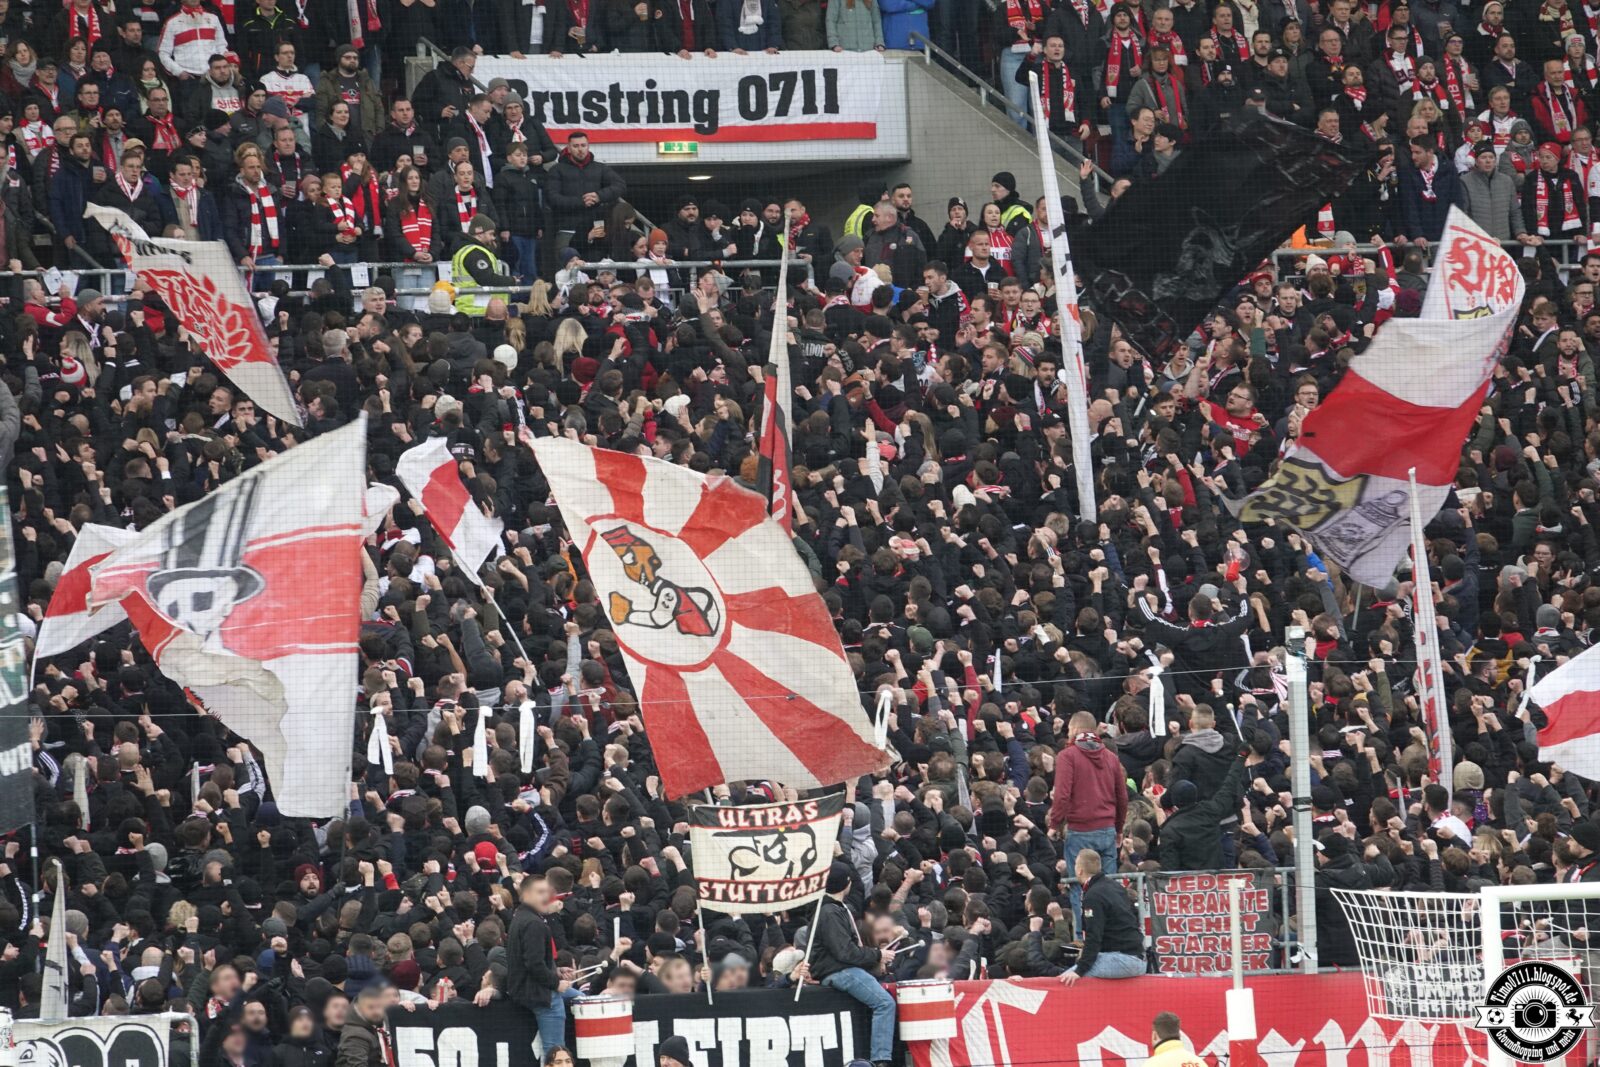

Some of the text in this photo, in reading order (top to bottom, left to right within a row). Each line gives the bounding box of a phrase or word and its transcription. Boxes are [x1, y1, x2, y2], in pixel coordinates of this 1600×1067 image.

[737, 68, 839, 121] 0711
[718, 802, 818, 827] ULTRAS
[1165, 873, 1256, 893] JEDER
